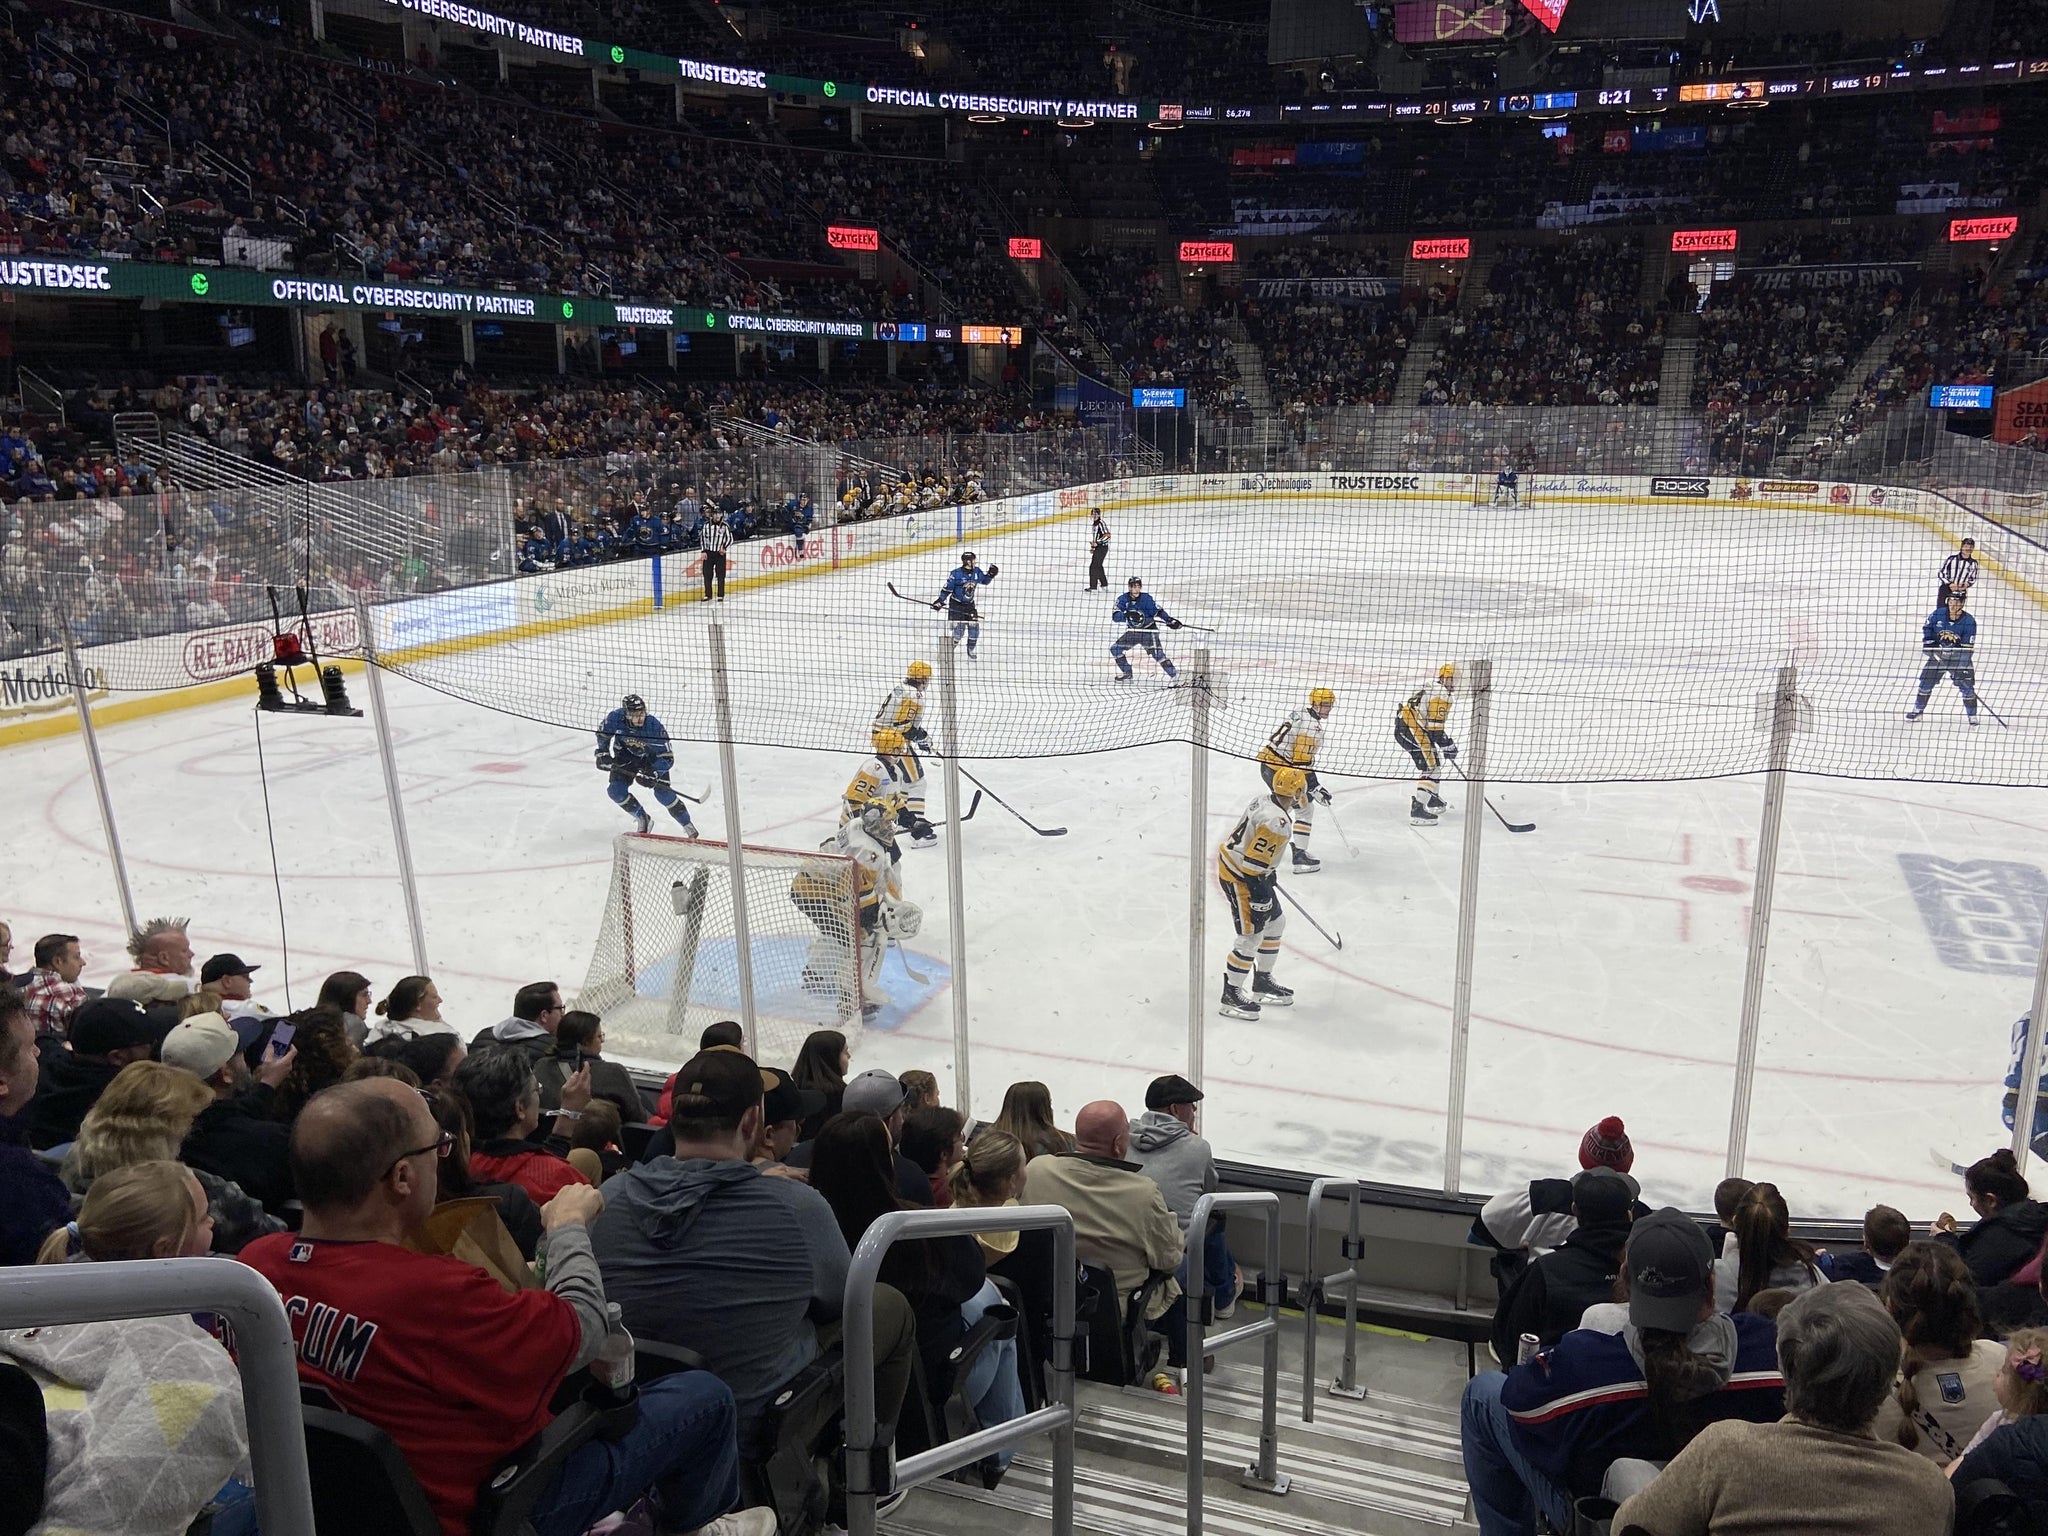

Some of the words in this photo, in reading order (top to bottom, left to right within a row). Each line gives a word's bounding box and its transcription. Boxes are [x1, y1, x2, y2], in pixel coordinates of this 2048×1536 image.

[403, 0, 515, 38] CYBERSECURITY
[519, 24, 584, 55] PARTNER
[679, 59, 766, 89] TRUSTEDSEC
[1769, 84, 1797, 94] SHOTS
[1806, 80, 1814, 92] 7
[1832, 79, 1859, 89] SAVES
[1864, 76, 1881, 88] 19
[867, 87, 934, 107] OFFICIAL
[939, 93, 1062, 116] CYBERSECURITY
[1067, 102, 1137, 118] PARTNER
[1396, 106, 1421, 115] SHOTS
[1425, 104, 1440, 115] 20
[1452, 103, 1475, 112] SAVES
[1483, 100, 1490, 110] 7
[1546, 94, 1552, 108] 1
[1599, 90, 1631, 105] 8:21
[1954, 222, 2012, 236] SEATGEEK
[830, 231, 875, 246] SEATGEEK
[1676, 233, 1733, 247] SEATGEEK
[1183, 246, 1230, 258] SEATGEEK
[1415, 243, 1466, 255] SEATGEEK
[0, 260, 111, 290] USTEDSEC
[1752, 273, 1792, 290] THE
[273, 279, 349, 304] OFFICIAL
[353, 285, 472, 312] CYBERSECURITY
[477, 295, 535, 315] PARTNER
[1257, 281, 1293, 298] THE
[1349, 281, 1386, 297] END
[615, 306, 673, 325] TRUSTEDSEC
[728, 315, 765, 330] OFFICIAL
[766, 318, 827, 335] CYBERSECURITY
[827, 322, 863, 336] PARTNER
[935, 329, 951, 338] SAVES
[1141, 388, 1175, 398] SHERWIN
[1942, 386, 1981, 398] SHERWIN
[1264, 477, 1312, 492] Technologies
[1330, 475, 1419, 489] TRUSTEDSEC
[854, 780, 876, 798] 25
[1253, 837, 1277, 858] 24
